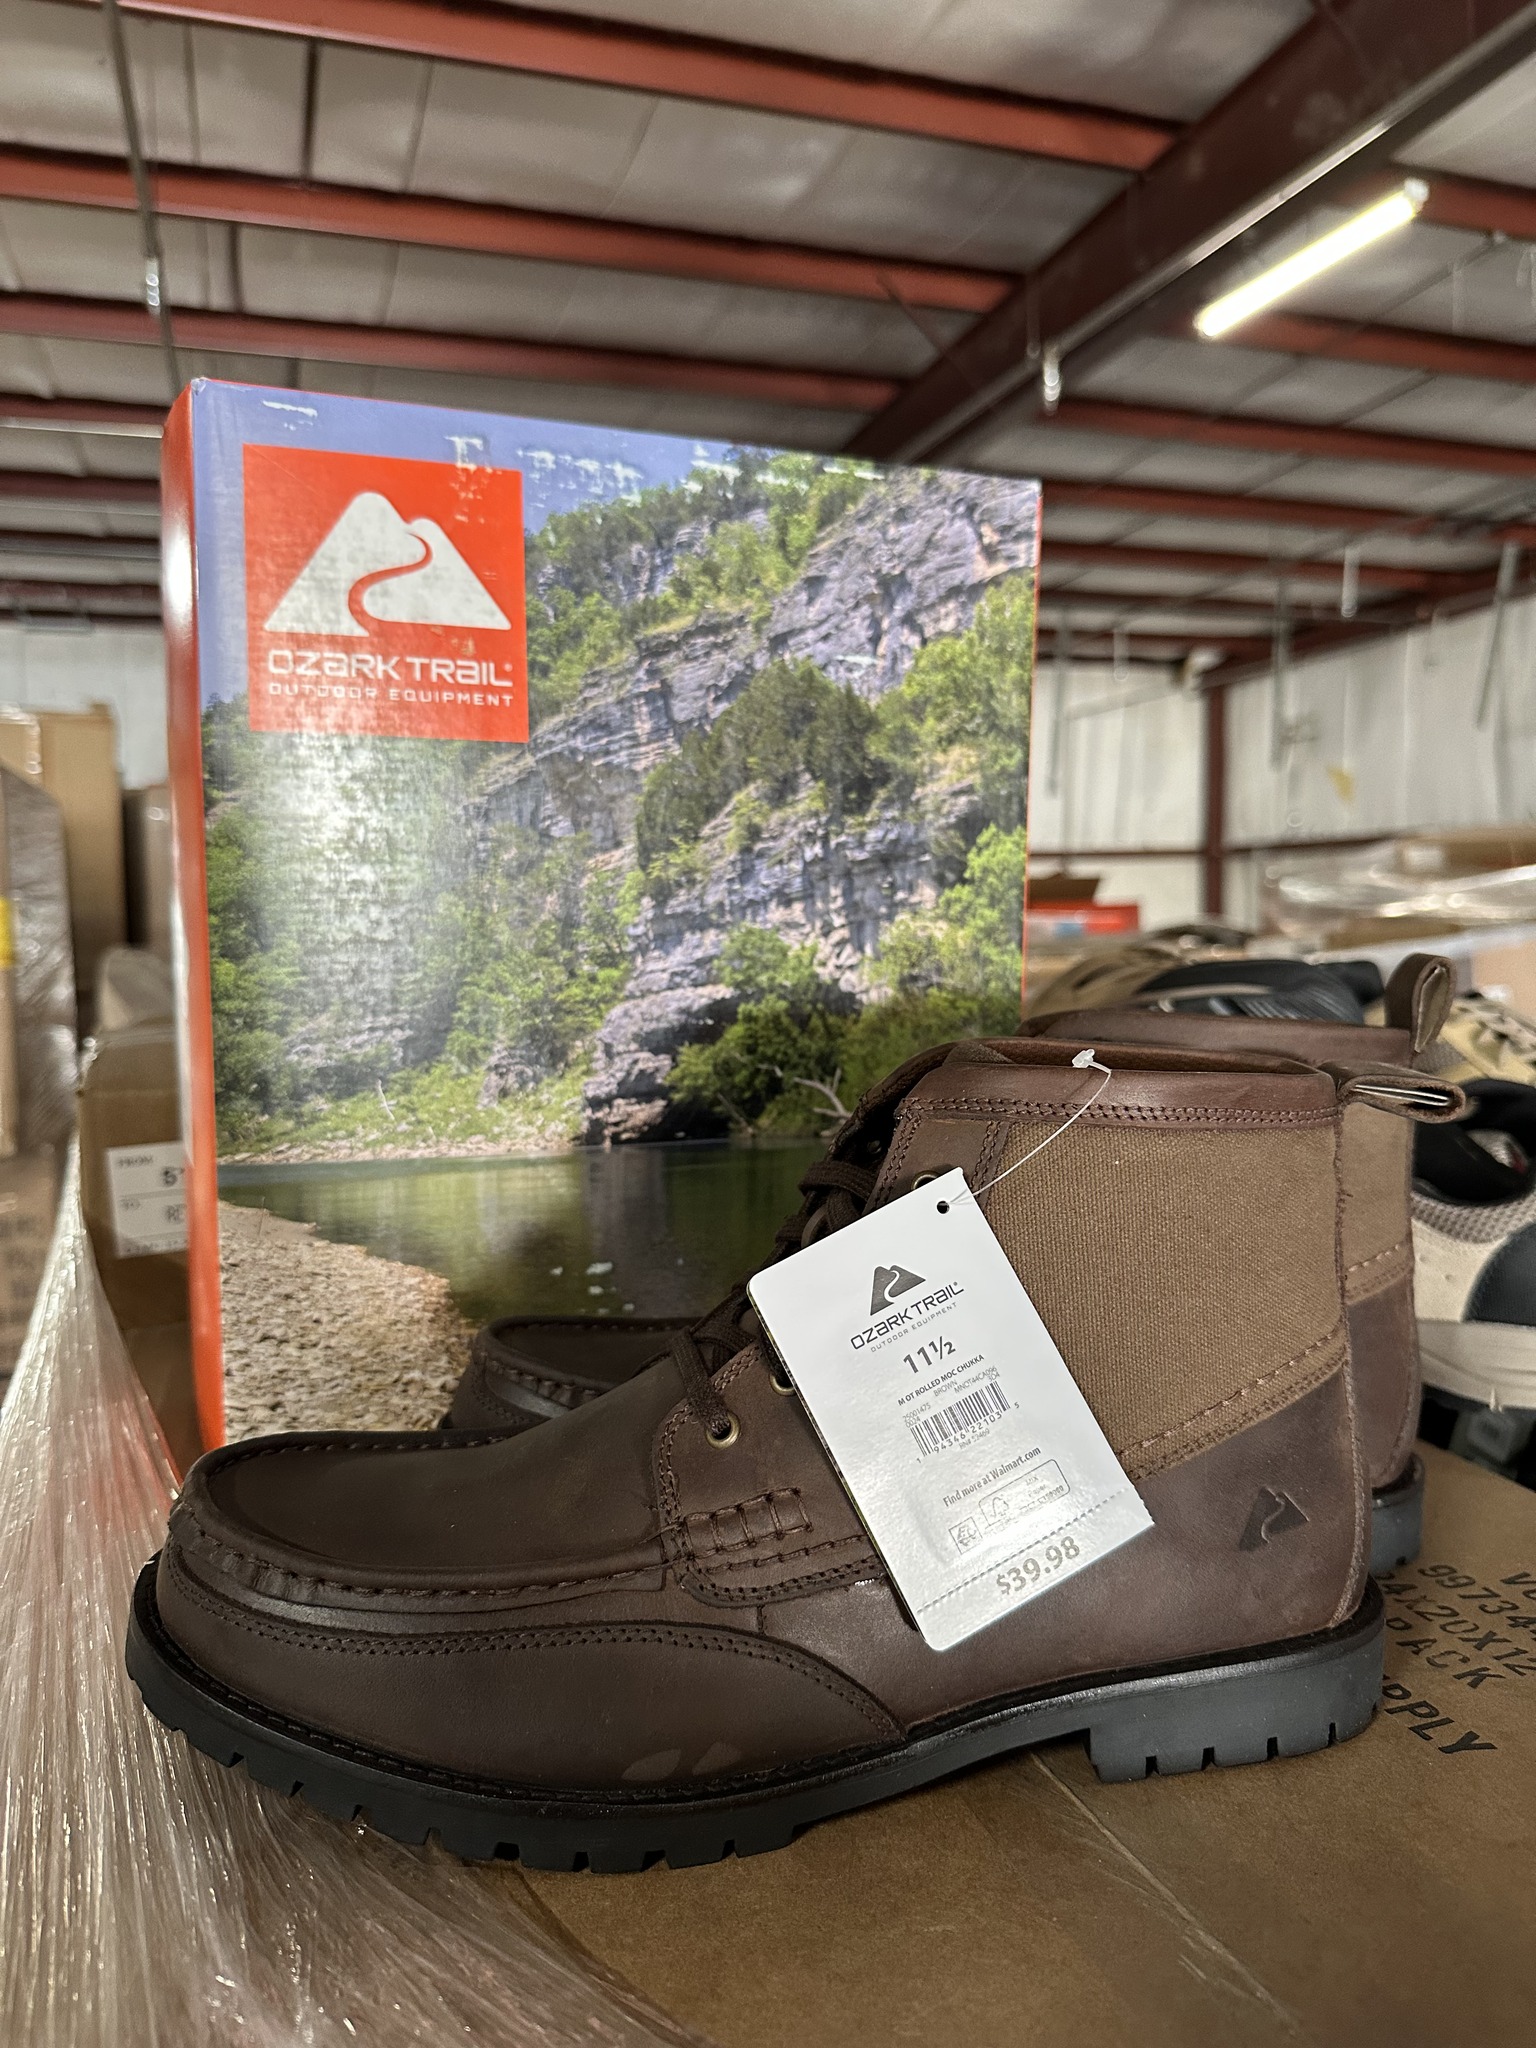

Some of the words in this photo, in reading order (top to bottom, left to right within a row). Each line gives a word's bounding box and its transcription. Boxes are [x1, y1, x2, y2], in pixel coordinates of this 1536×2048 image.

[267, 648, 401, 681] OZARK
[268, 682, 378, 699] OUTDOOR
[389, 688, 514, 707] EQUIPMENT
[850, 1307, 914, 1350] OZARK
[870, 1328, 909, 1353] OUTDOOR
[911, 1302, 958, 1330] EQUIPMENT
[897, 1398, 906, 1406] M
[905, 1392, 915, 1403] OT
[914, 1378, 941, 1397] ROLLED
[940, 1368, 958, 1383] MOC
[956, 1354, 985, 1374] CHUKKA
[933, 1379, 958, 1397] BROWN
[933, 1432, 966, 1454] 94346
[969, 1411, 1003, 1434] 22103
[1014, 1401, 1020, 1409] 5
[942, 1490, 961, 1508] Find
[961, 1481, 983, 1499] more
[982, 1474, 992, 1487] at
[990, 1447, 1042, 1480] Walmart.com
[995, 1535, 1081, 1596] $39.98
[1417, 1564, 1536, 1642] 99734
[1381, 1674, 1499, 1755] PPLY
